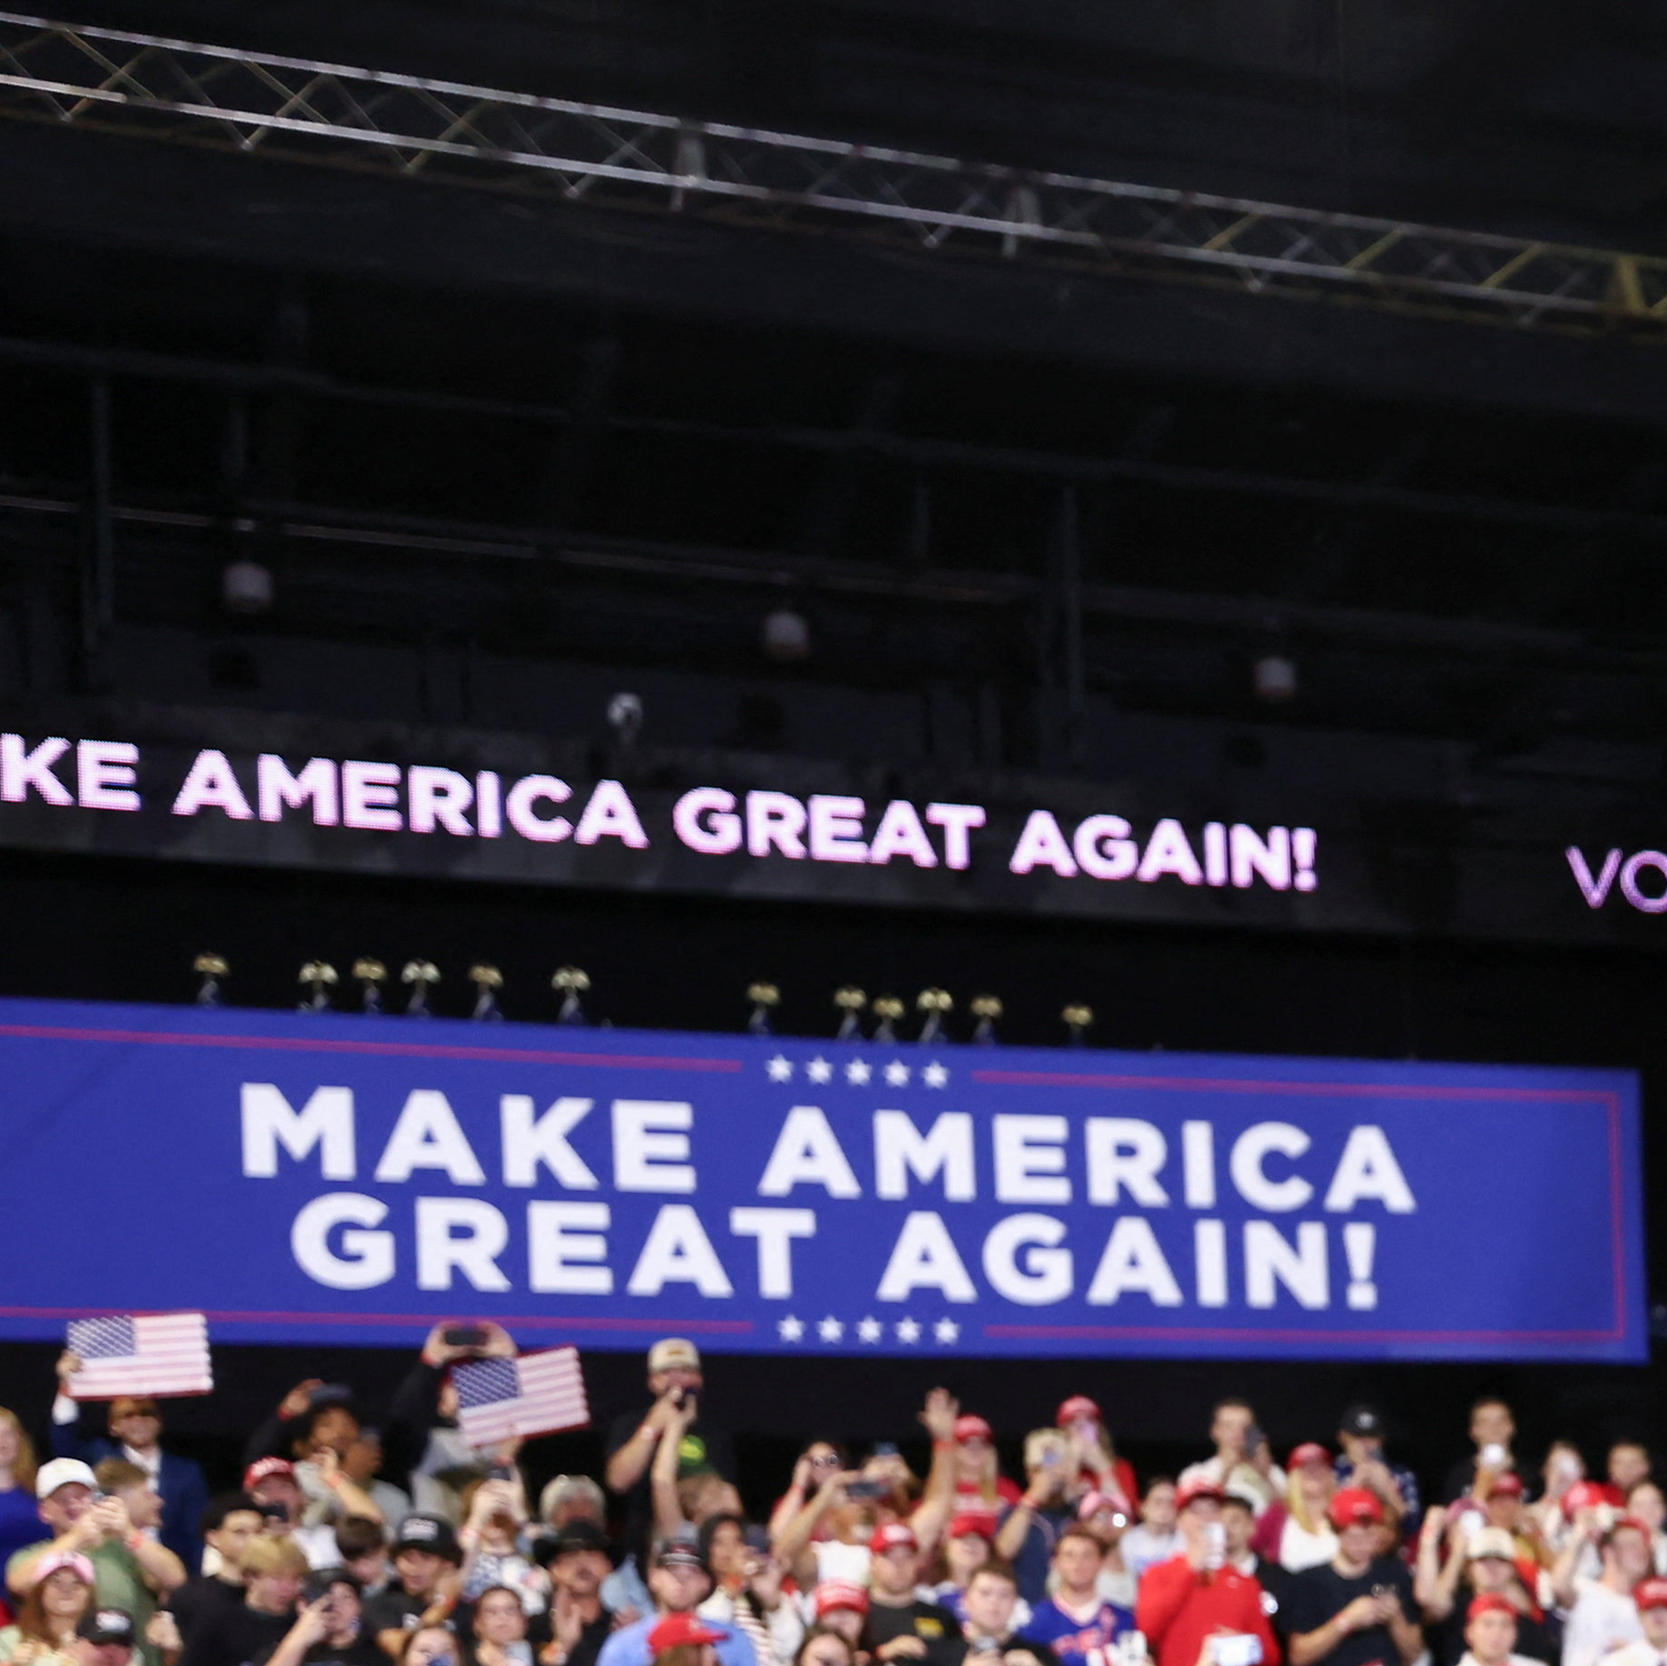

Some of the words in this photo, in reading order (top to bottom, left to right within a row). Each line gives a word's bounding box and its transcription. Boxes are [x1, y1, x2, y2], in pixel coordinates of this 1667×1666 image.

[0, 732, 142, 812] KE
[171, 748, 650, 849] AMERICA
[672, 785, 987, 871] GREAT
[1009, 808, 1318, 893] AGAIN!
[241, 1082, 697, 1194] MAKE
[758, 1105, 1416, 1214] AMERICA
[291, 1192, 817, 1299] GREAT
[876, 1210, 1377, 1310] AGAIN!
